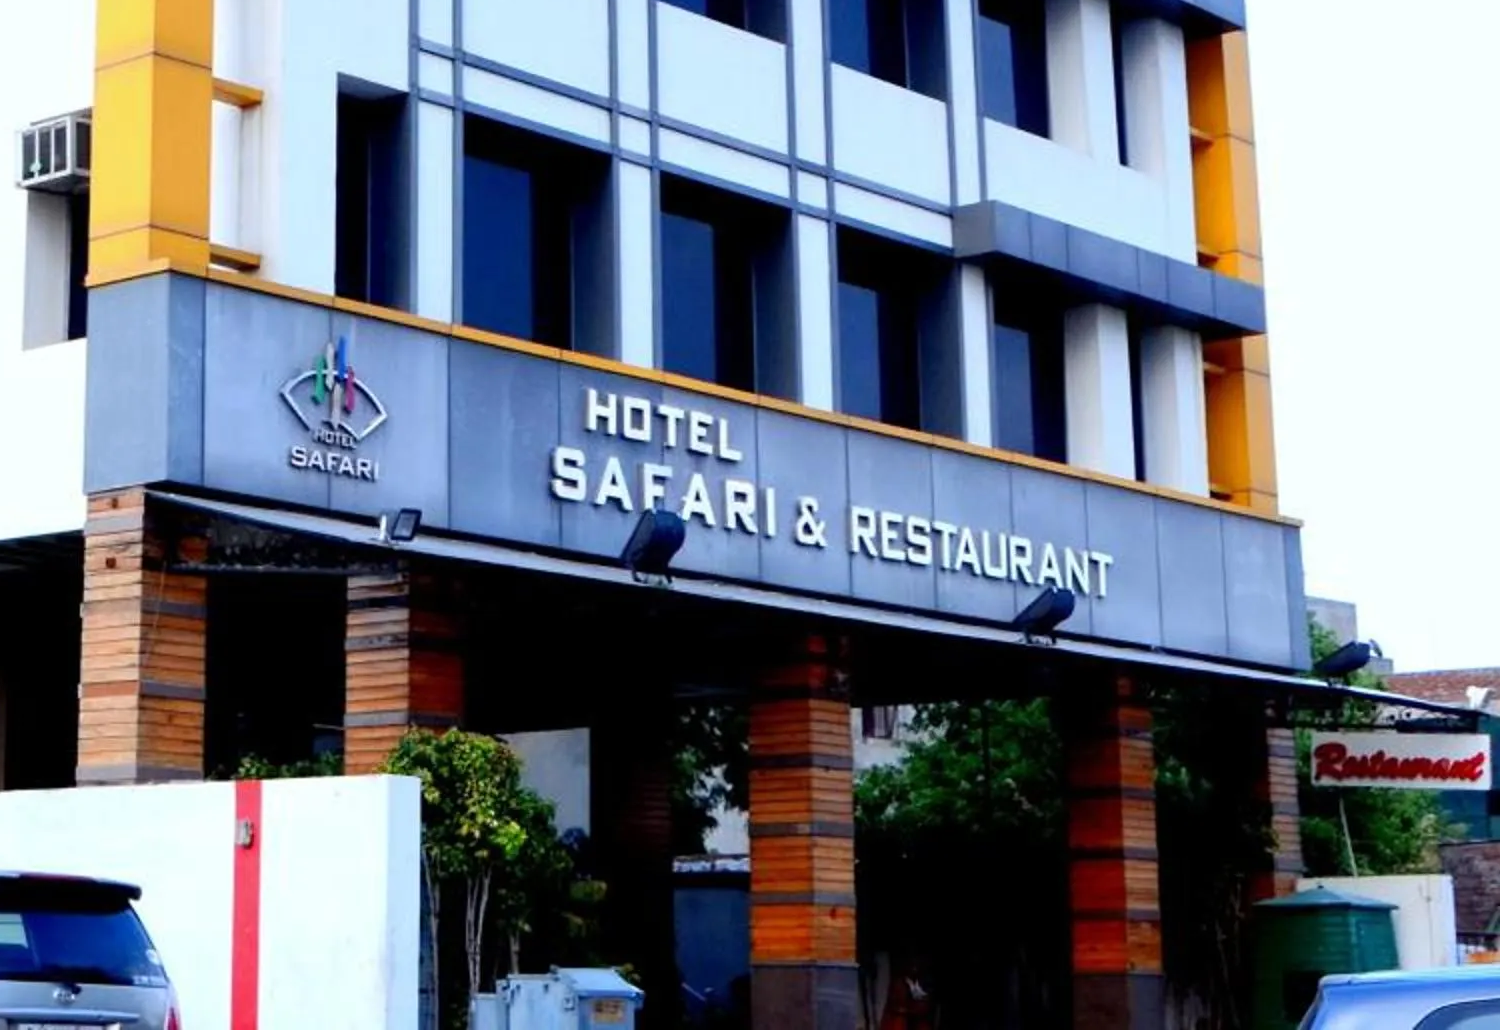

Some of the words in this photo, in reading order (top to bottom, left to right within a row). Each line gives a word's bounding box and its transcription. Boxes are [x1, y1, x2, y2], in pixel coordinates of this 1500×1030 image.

[585, 388, 742, 462] HOTEL
[290, 446, 379, 481] SAFARI
[550, 446, 776, 537] SAFARI
[796, 496, 827, 548] &
[850, 505, 1114, 598] RESTAURANT
[1314, 741, 1485, 782] Restaurant
